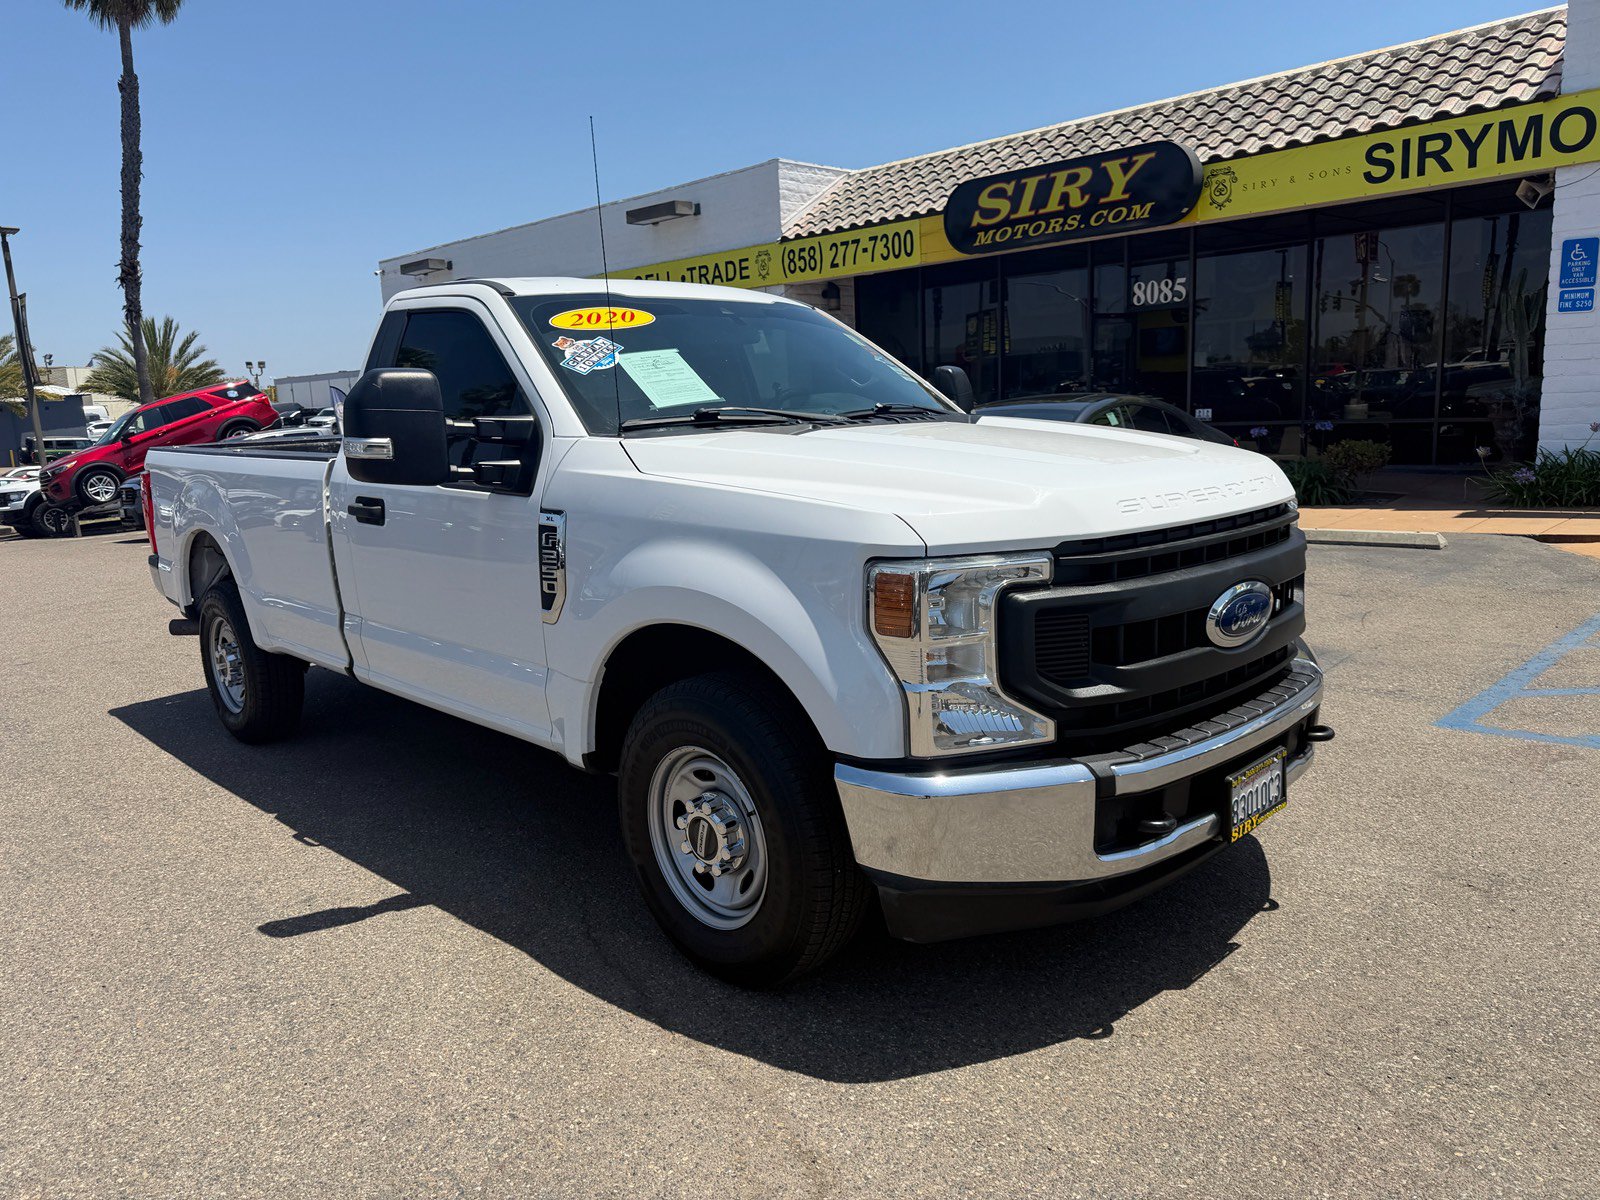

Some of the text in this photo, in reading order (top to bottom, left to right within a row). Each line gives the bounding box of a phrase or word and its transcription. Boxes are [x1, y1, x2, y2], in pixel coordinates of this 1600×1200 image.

[1362, 106, 1598, 185] SIRYMO
[970, 152, 1156, 228] SIRY
[1242, 165, 1352, 192] SIRY & SONS
[973, 202, 1155, 247] MOTORS.COM
[781, 241, 824, 278] (858)
[829, 229, 915, 269] 277-7300
[1133, 277, 1187, 306] 8085
[570, 310, 636, 327] 2020
[567, 340, 609, 367] CARFAX
[1231, 601, 1264, 631] Ford
[1231, 814, 1260, 843] SIRY
